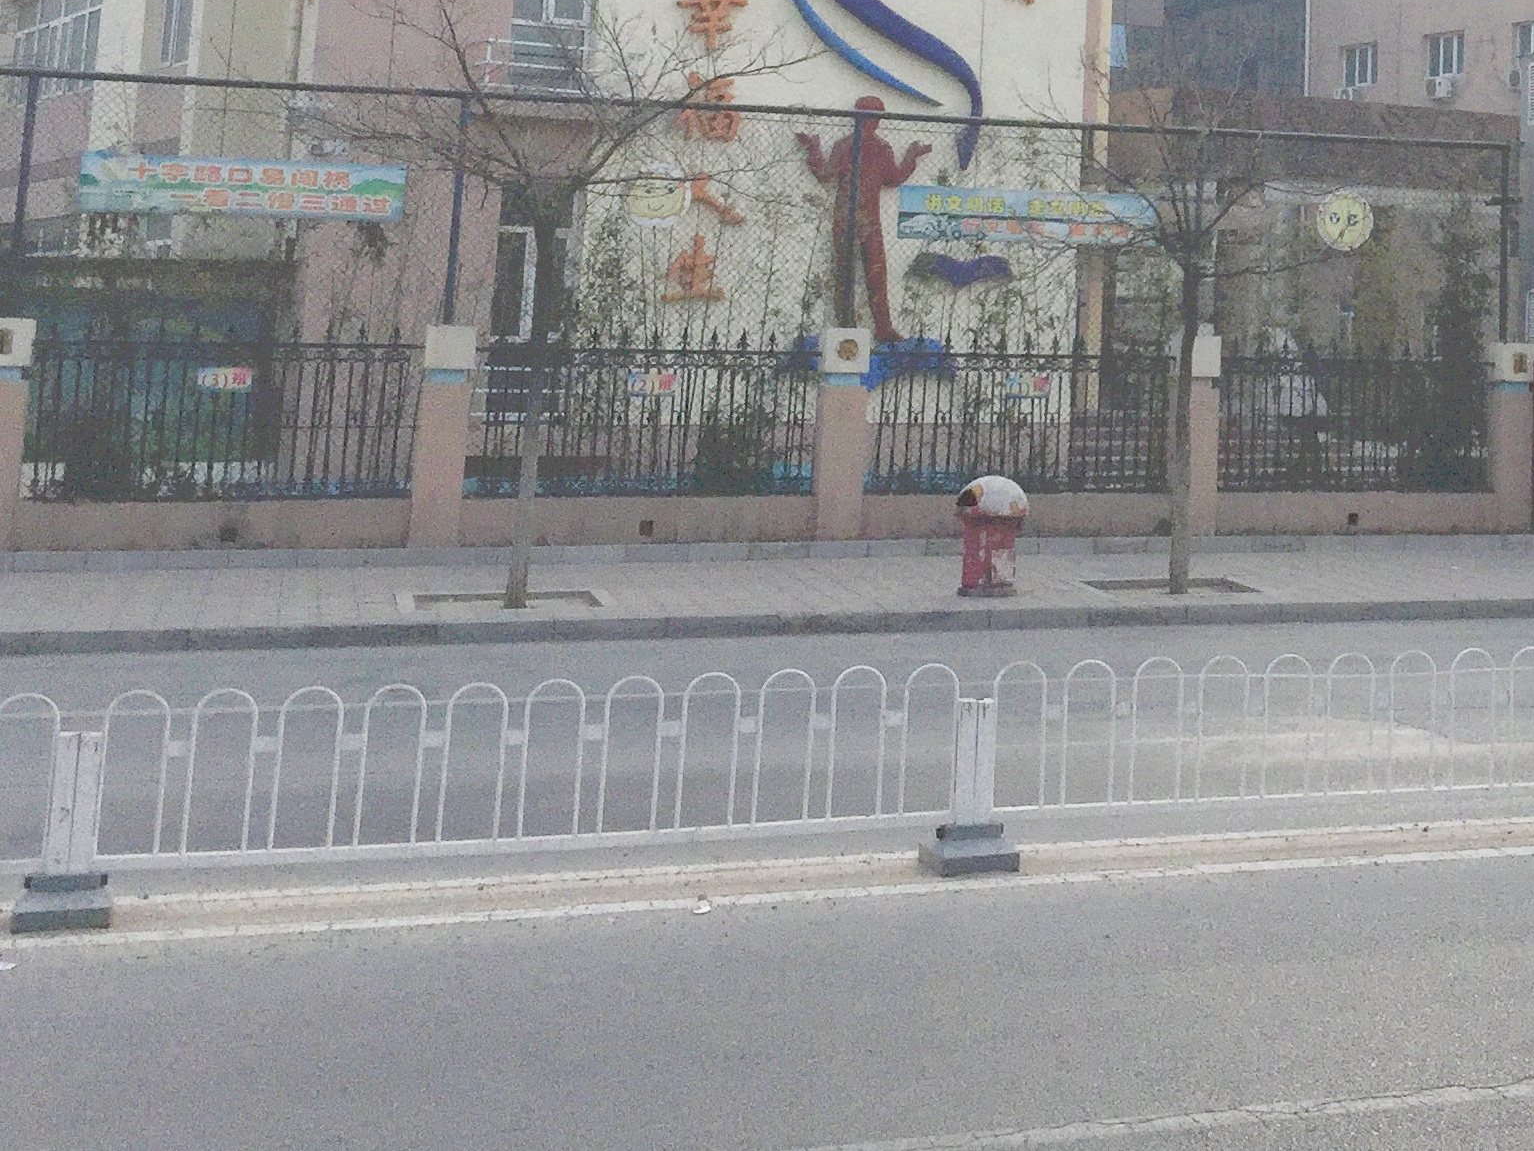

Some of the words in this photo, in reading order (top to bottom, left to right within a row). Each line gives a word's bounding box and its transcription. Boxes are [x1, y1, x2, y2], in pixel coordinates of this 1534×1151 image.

[170, 189, 391, 215] 一看二慢三通过
